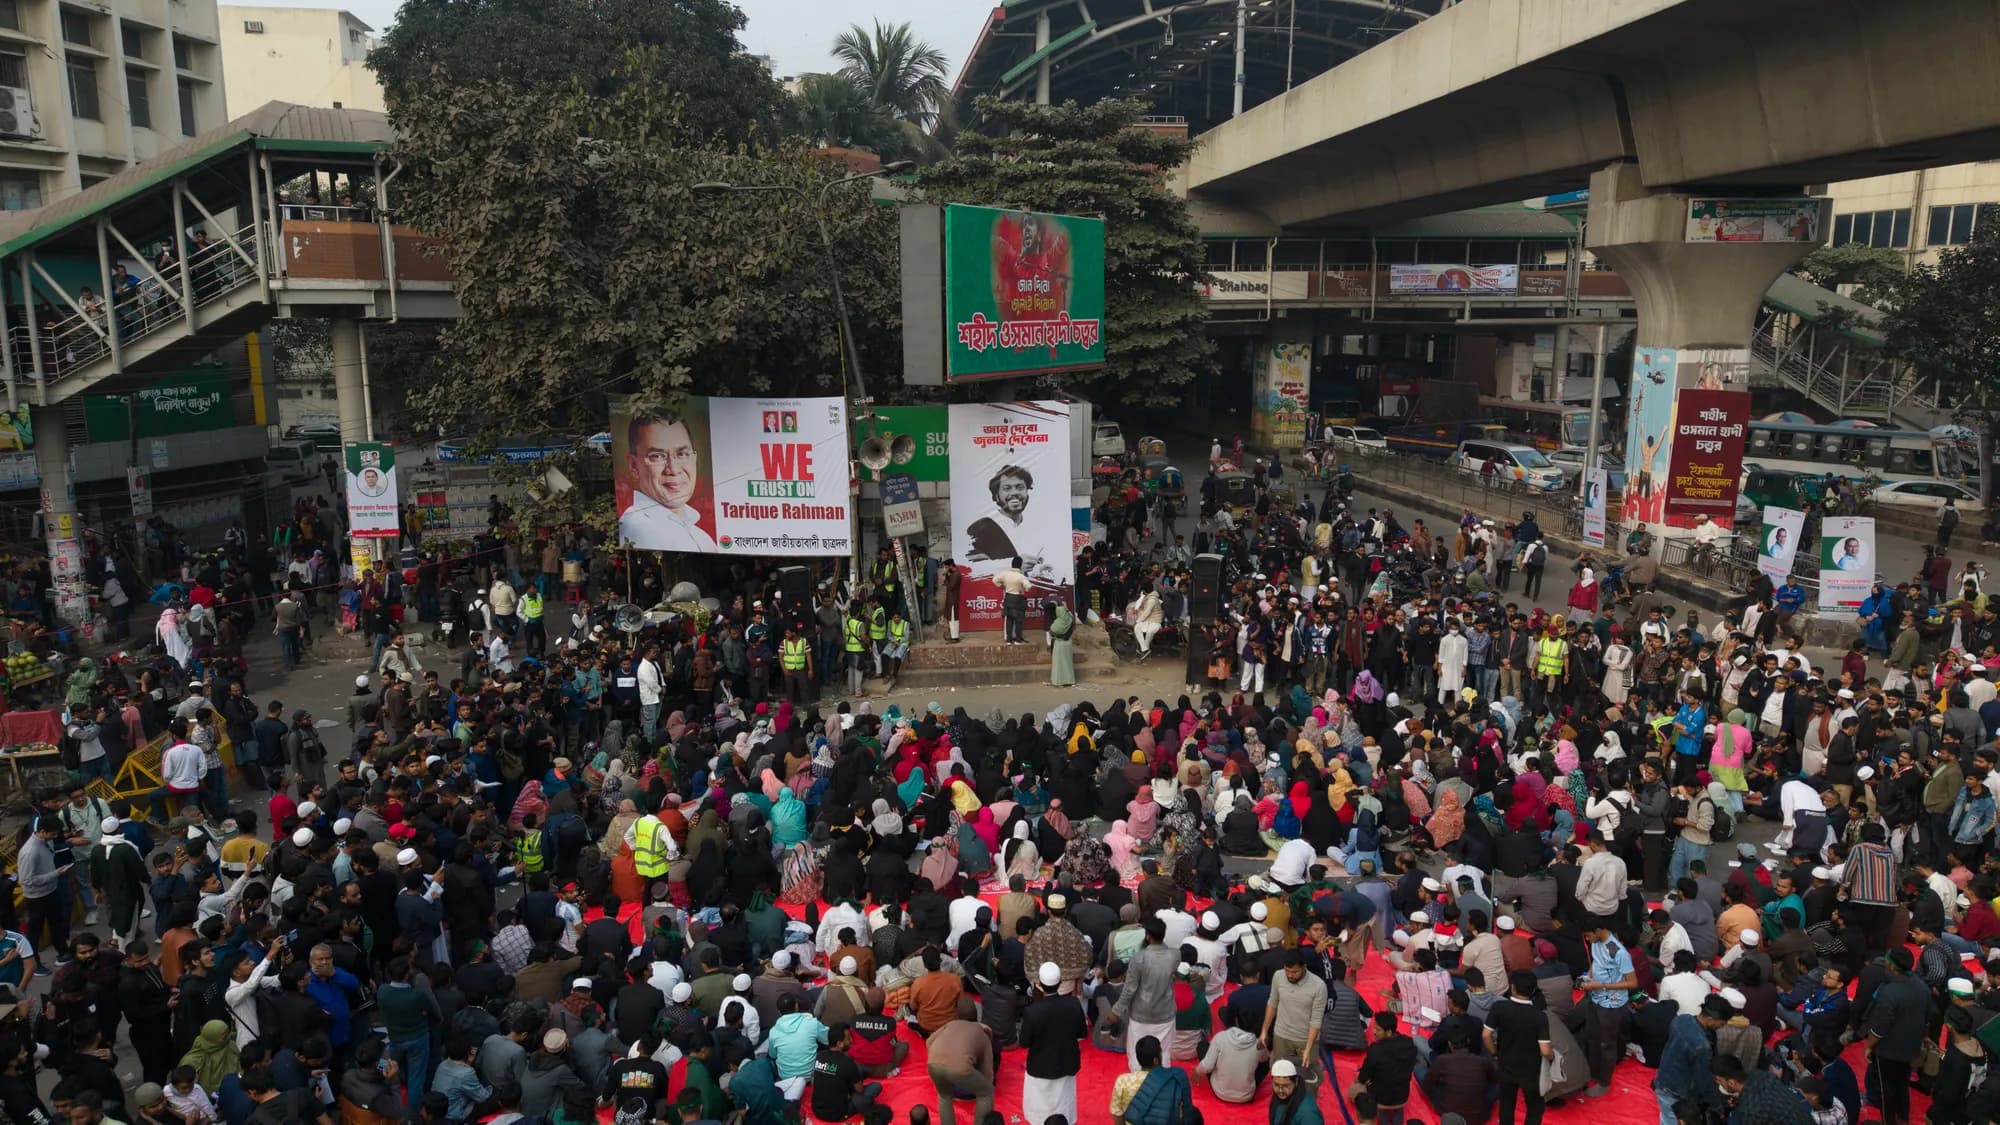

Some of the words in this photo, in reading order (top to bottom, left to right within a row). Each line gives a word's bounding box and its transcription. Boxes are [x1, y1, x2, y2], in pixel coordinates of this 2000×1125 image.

[1018, 280, 1032, 292] জান
[1034, 275, 1050, 293] দিবো
[1011, 296, 1032, 316] জুলাই
[958, 312, 997, 351] শহীদ
[999, 321, 1044, 348] ওসমান
[1045, 311, 1070, 350] হাদী
[1072, 319, 1099, 348] চত্বর
[154, 396, 187, 413] নিরাপদে
[1699, 408, 1728, 422] শহীদ
[983, 425, 1009, 435] জান
[1010, 424, 1038, 436] দেবো
[1680, 425, 1717, 437] ওসমান
[1720, 423, 1743, 438] হাদী
[972, 433, 1007, 448] জুলাই
[760, 443, 814, 480] WE
[1688, 462, 1724, 478] ইসলামী
[751, 481, 792, 497] TRUST
[796, 481, 815, 497] ON
[1683, 487, 1722, 499] বাংলাদেশ
[721, 502, 778, 520] Tarique
[782, 503, 844, 520] Rahman
[734, 535, 769, 549] বাংলাদেশ
[772, 534, 819, 550] জাতীয়তাবাদী
[822, 536, 848, 550] ছাত্রদল
[966, 596, 997, 610] শরীফ
[856, 1021, 873, 1030] DHAKA
